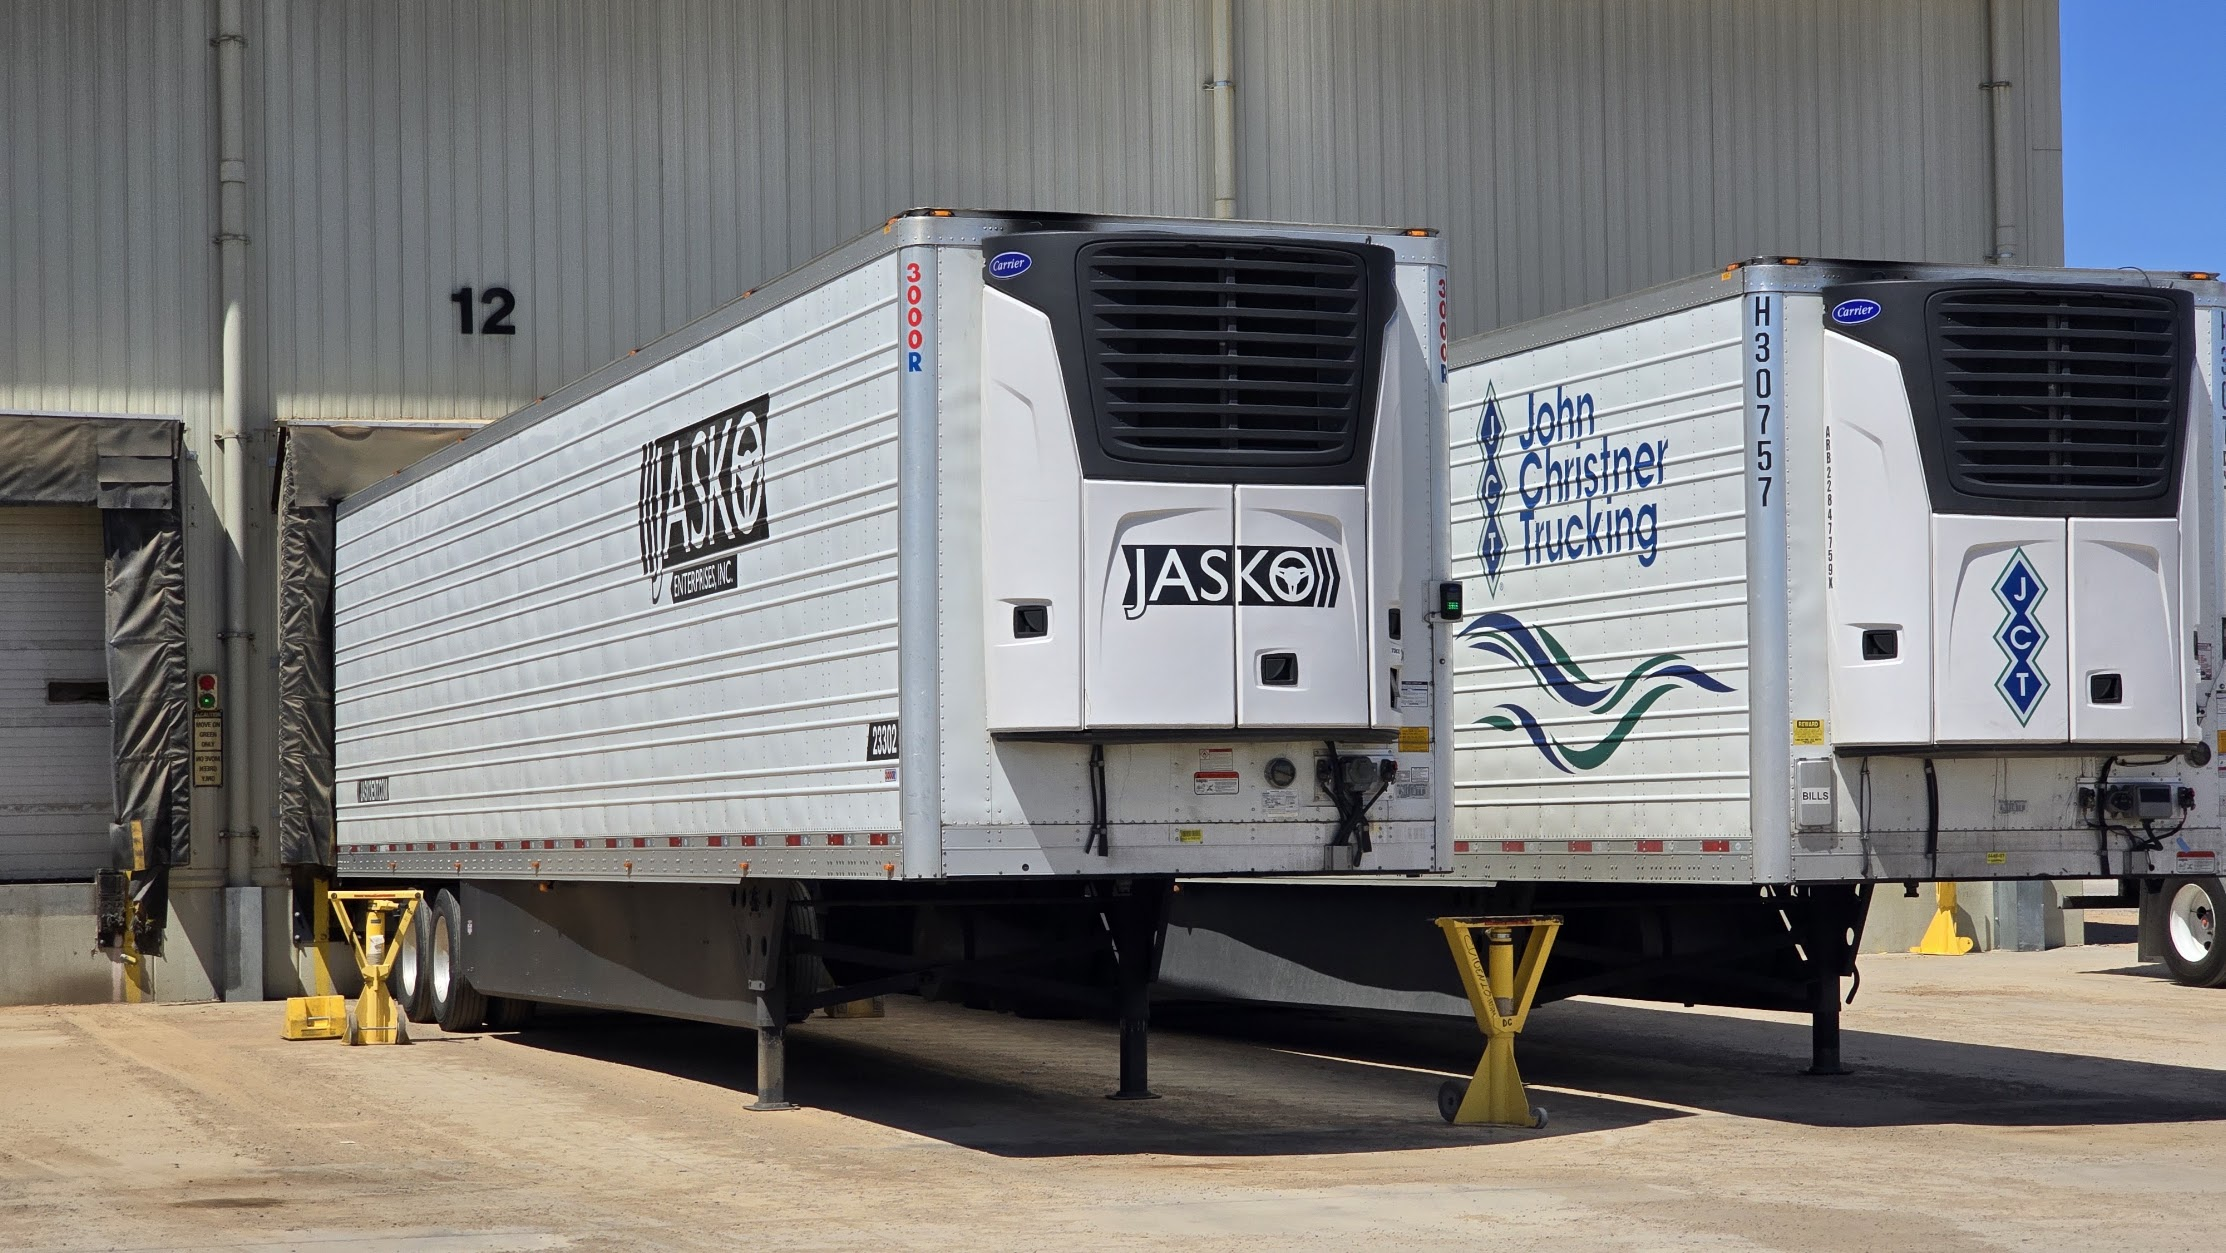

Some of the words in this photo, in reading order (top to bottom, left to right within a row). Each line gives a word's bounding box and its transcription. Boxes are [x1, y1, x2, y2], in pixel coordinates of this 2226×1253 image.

[993, 259, 1025, 272] Carrier
[451, 287, 516, 334] 12
[907, 263, 922, 372] 3000R
[1837, 305, 1874, 318] Carrier
[1519, 386, 1595, 450] John
[1755, 296, 1772, 507] H30757
[1519, 436, 1669, 509] Christner
[651, 411, 763, 603] JASKO
[1519, 497, 1658, 567] Trucking
[674, 565, 717, 597] ENTERPRISES,
[717, 560, 734, 586] INC.
[1123, 547, 1316, 621] JASKO
[2009, 576, 2033, 697] JCT
[872, 724, 897, 755] 23302
[1802, 791, 1829, 801] BILLS
